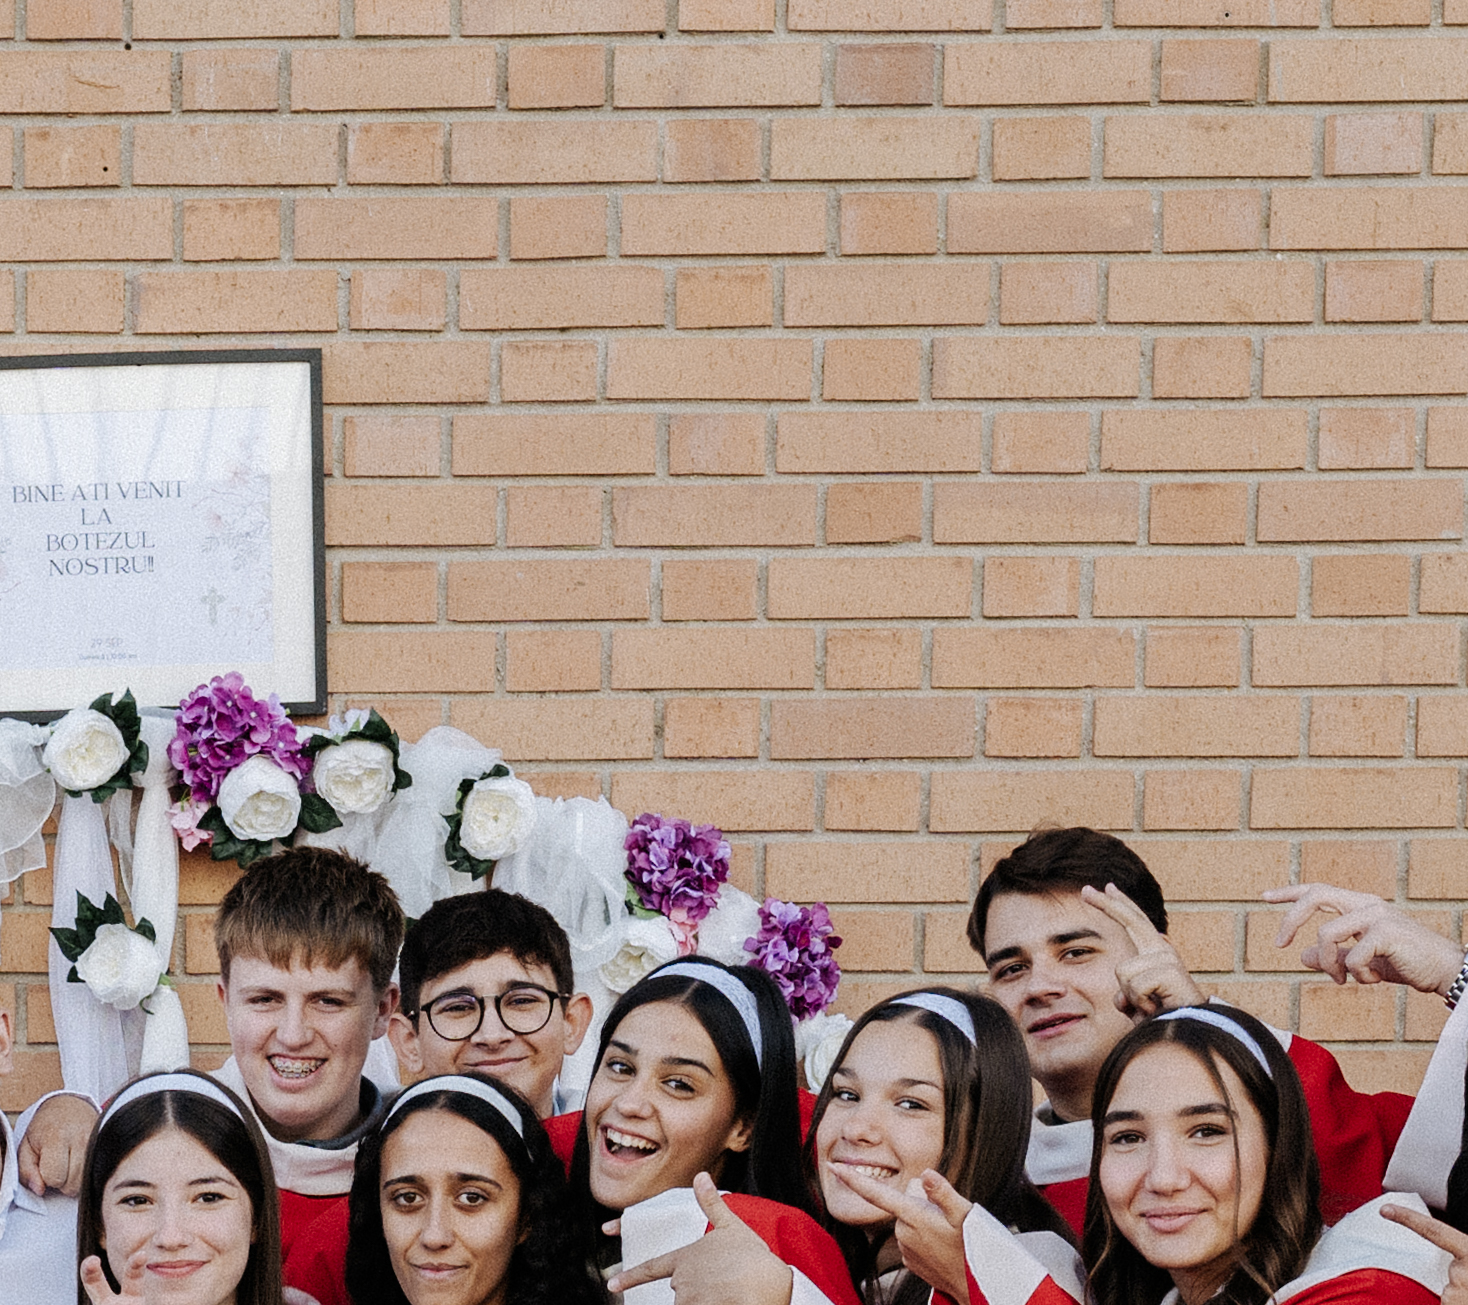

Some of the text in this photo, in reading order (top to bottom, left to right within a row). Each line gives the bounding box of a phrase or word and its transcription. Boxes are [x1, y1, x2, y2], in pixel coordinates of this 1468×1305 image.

[12, 484, 65, 503] BINE
[116, 480, 186, 500] VENIT
[81, 508, 112, 525] LA
[46, 531, 155, 551] BOTEZUL
